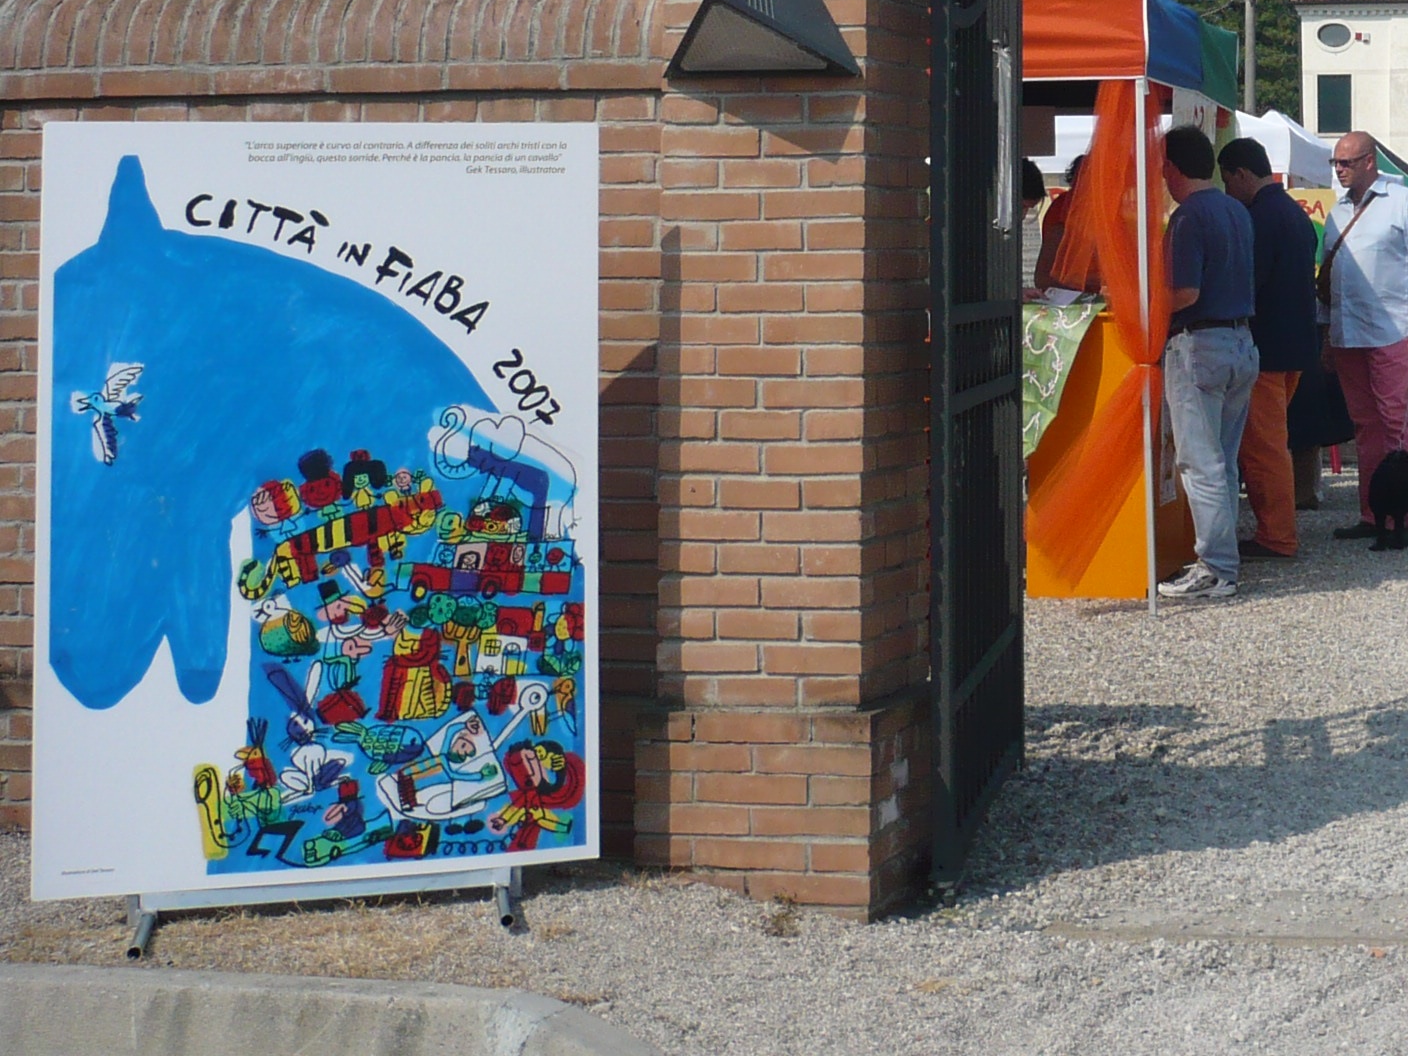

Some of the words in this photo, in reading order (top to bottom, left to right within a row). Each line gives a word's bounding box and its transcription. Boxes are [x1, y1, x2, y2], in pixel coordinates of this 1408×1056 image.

[276, 141, 318, 151] superiore
[326, 142, 352, 150] curvo
[353, 141, 363, 150] al
[406, 141, 413, 150] A
[414, 140, 459, 150] differenza
[460, 140, 474, 150] dei
[475, 140, 496, 150] soliti
[497, 141, 520, 150] archi
[521, 140, 541, 150] tristi
[541, 142, 558, 150] con
[558, 140, 568, 150] la
[248, 154, 276, 162] bocca
[316, 153, 347, 164] questo
[420, 153, 429, 162] la
[463, 152, 472, 162] la
[472, 153, 504, 163] pancia
[504, 152, 514, 162] di
[514, 154, 527, 162] un
[465, 165, 483, 174] Gek
[519, 165, 566, 174] illustratore
[185, 194, 330, 253] CITTÀ
[376, 246, 490, 334] FIABA
[492, 348, 561, 426] 2007
